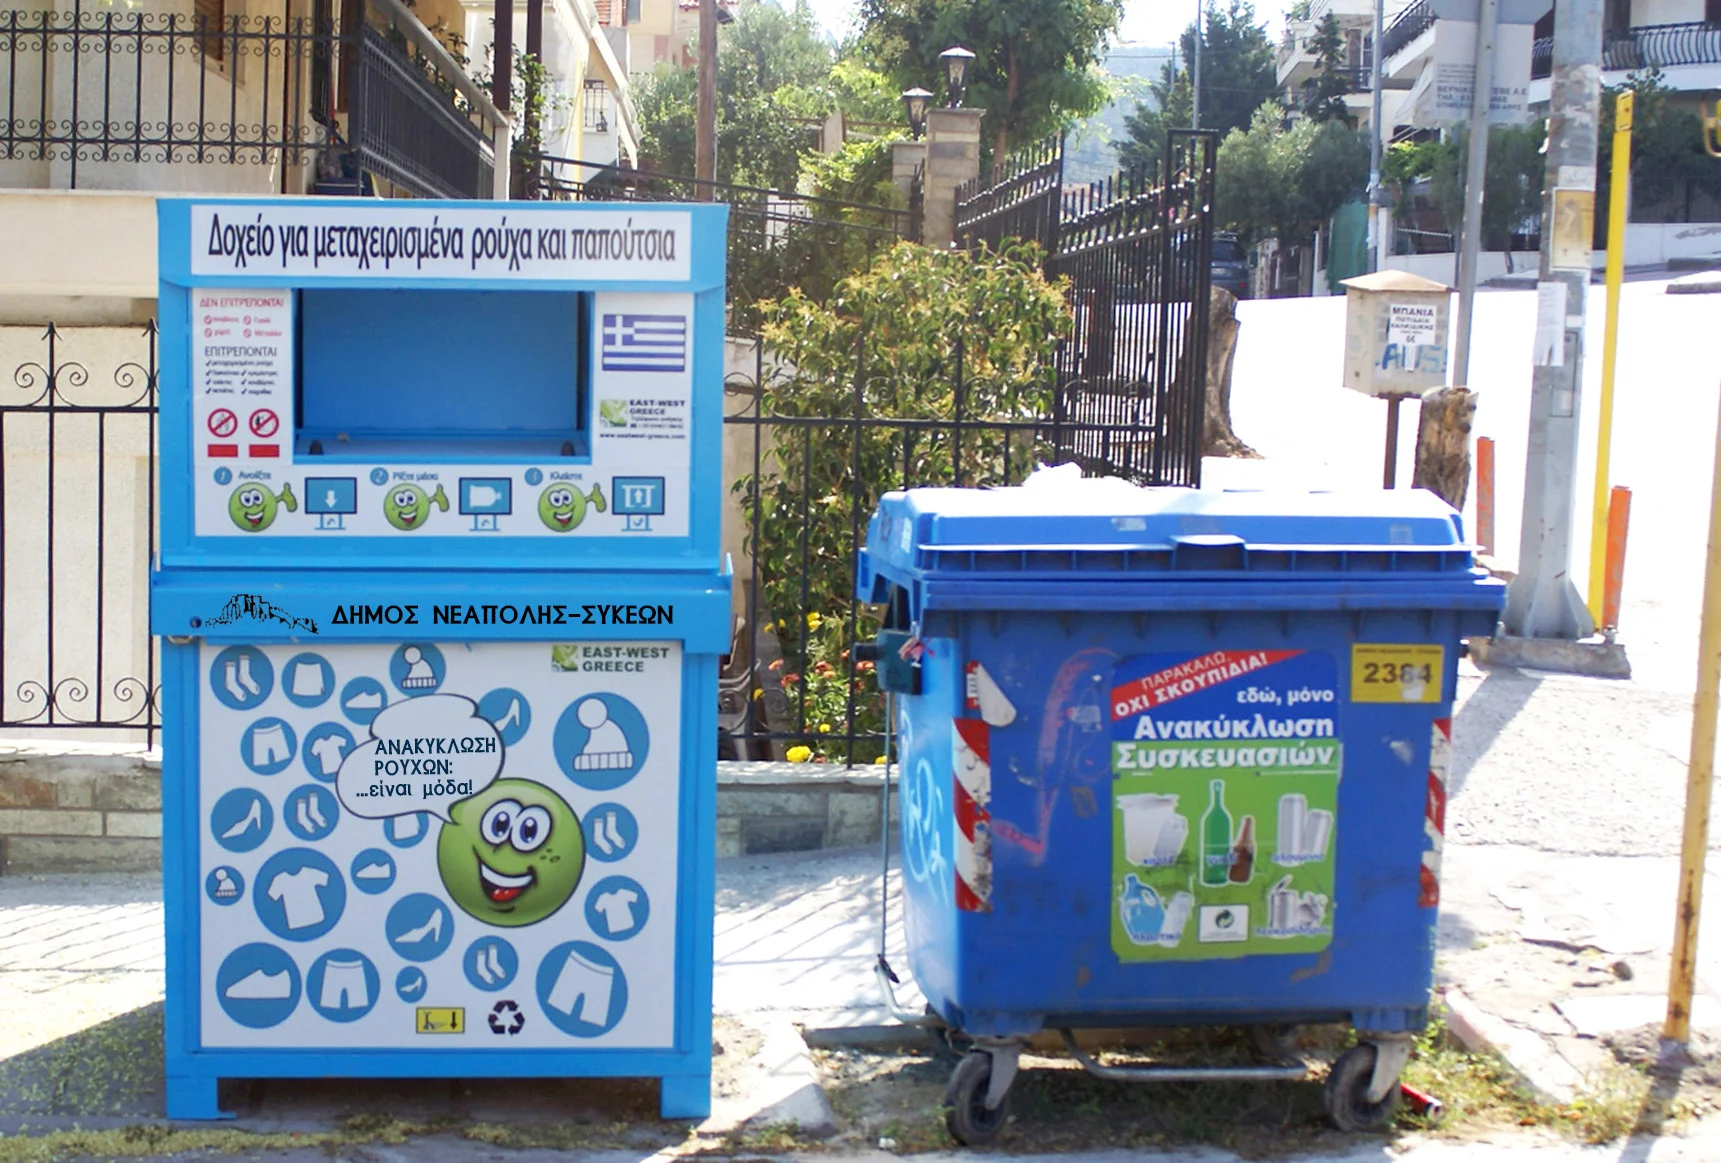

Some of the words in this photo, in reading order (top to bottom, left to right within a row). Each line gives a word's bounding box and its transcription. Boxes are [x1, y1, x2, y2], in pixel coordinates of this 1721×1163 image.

[208, 213, 275, 268] Δοχείο
[279, 225, 308, 268] για
[314, 215, 464, 270] μεταχειρισμένα
[471, 216, 532, 271] ρούχα
[538, 229, 566, 260] και
[572, 218, 676, 261] παπούτσια
[200, 298, 218, 307] ΔΕΝ
[1392, 307, 1434, 317] ΜΠΑΝΙΑ
[331, 605, 419, 625] ΔΗΜΟΣ
[433, 605, 673, 625] ΝΕΑΠΟΛΗΣ-ΣΥΚΕΩΝ
[582, 646, 670, 658] EAST-WEST
[582, 660, 644, 672] GREECE
[1115, 694, 1150, 717] ΟΧΙ
[1154, 652, 1268, 703] ΣΚΟΥΠΙΔΙΑ!
[1287, 687, 1334, 706] μόνο
[1134, 713, 1334, 740] Ανακύκλωση
[375, 737, 496, 755] ΑΝΑΚΥΚΛΩΣΗ
[1116, 740, 1334, 769] Συσκευασιών
[374, 759, 453, 776] ΡΟΥΧΩΝ:
[422, 779, 473, 799] μόδα!
